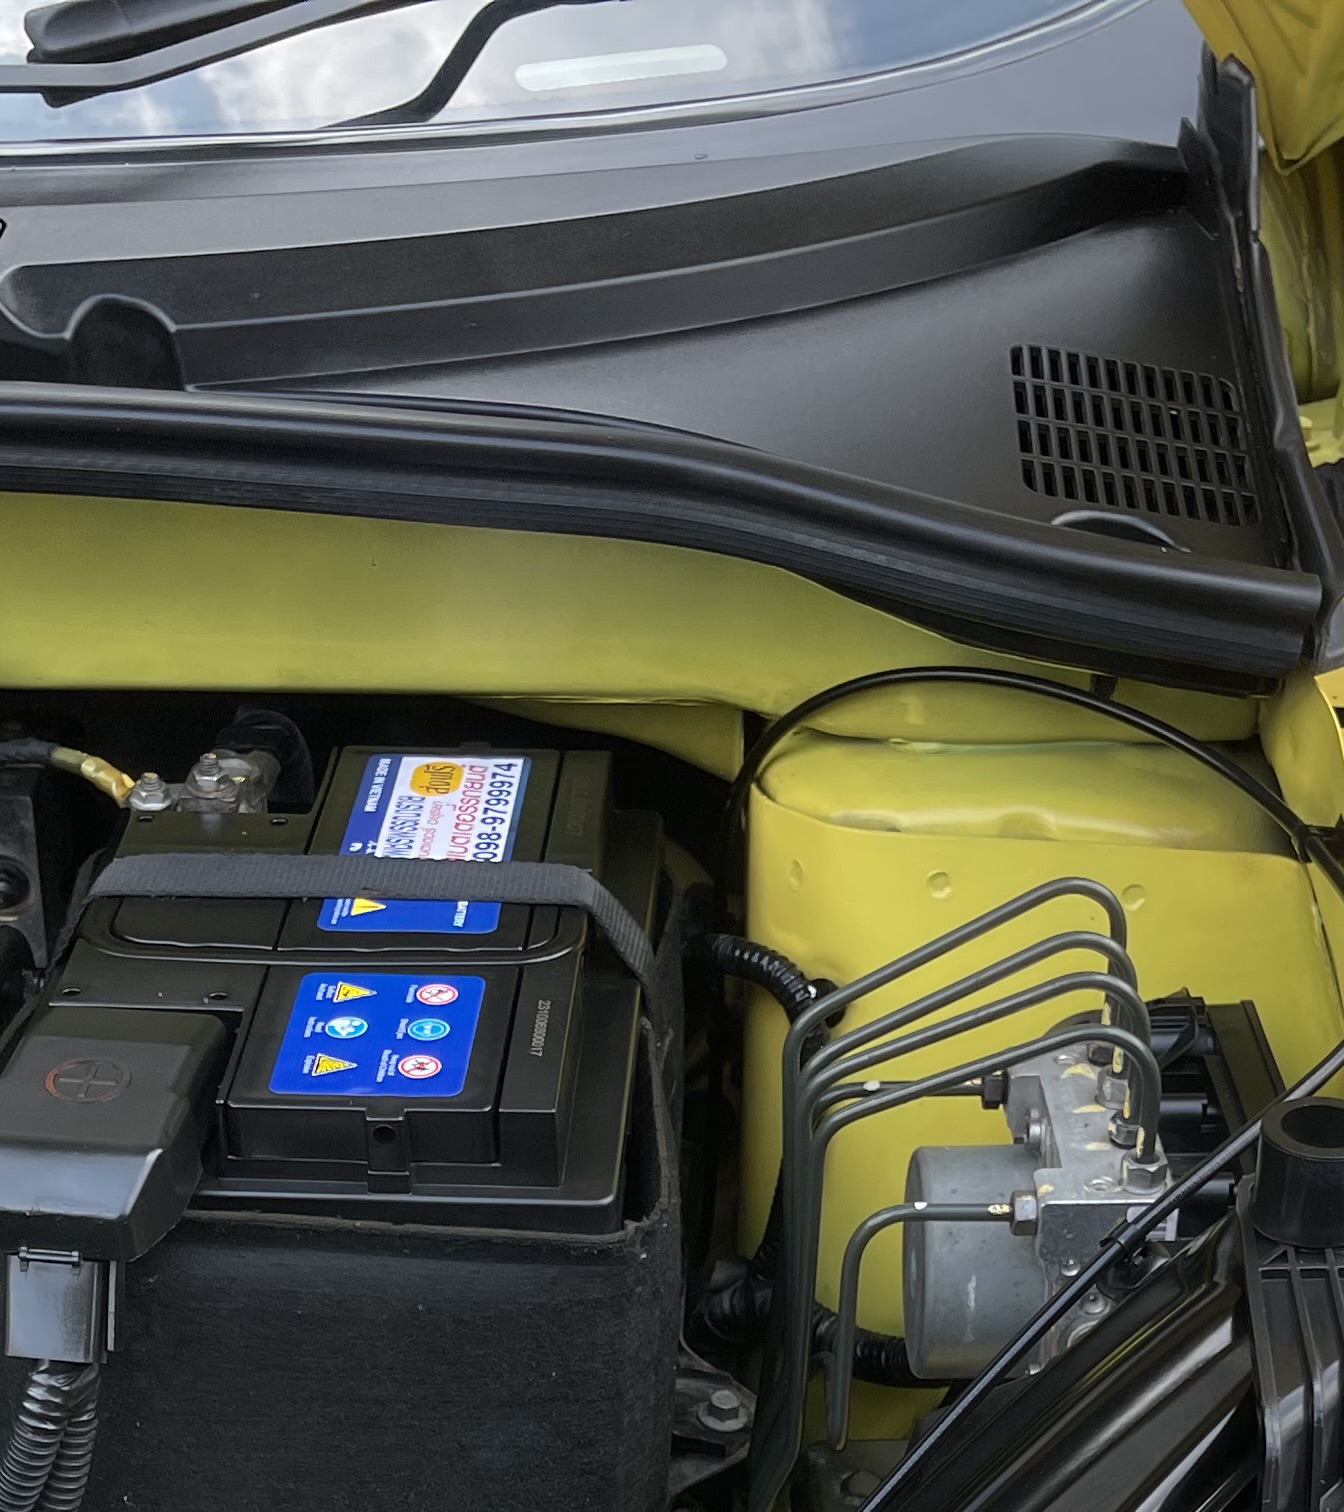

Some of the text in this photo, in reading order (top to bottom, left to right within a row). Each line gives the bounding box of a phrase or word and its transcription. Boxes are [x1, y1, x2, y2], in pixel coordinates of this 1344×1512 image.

[419, 764, 456, 795] ส่งฟรี
[364, 784, 385, 812] VIETNAM
[472, 763, 517, 862] 098-9799974
